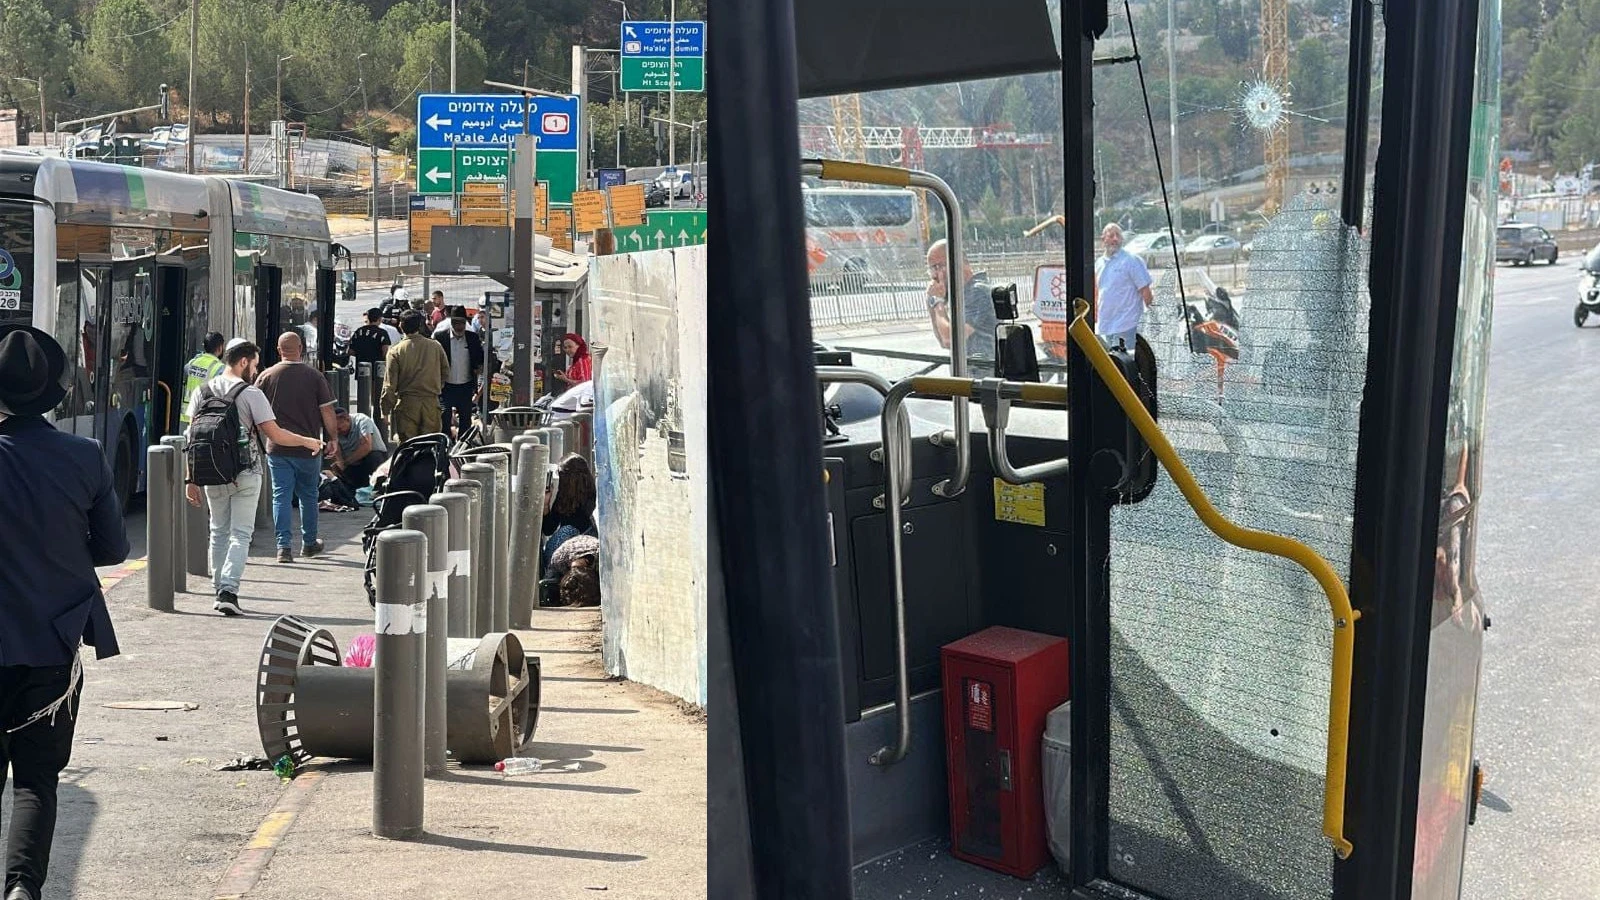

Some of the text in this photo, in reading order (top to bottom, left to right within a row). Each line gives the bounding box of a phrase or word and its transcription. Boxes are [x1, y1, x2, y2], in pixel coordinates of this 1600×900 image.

[448, 101, 537, 113] מעלה אדומים
[553, 120, 558, 128] 1
[444, 133, 484, 143] Ma'ale
